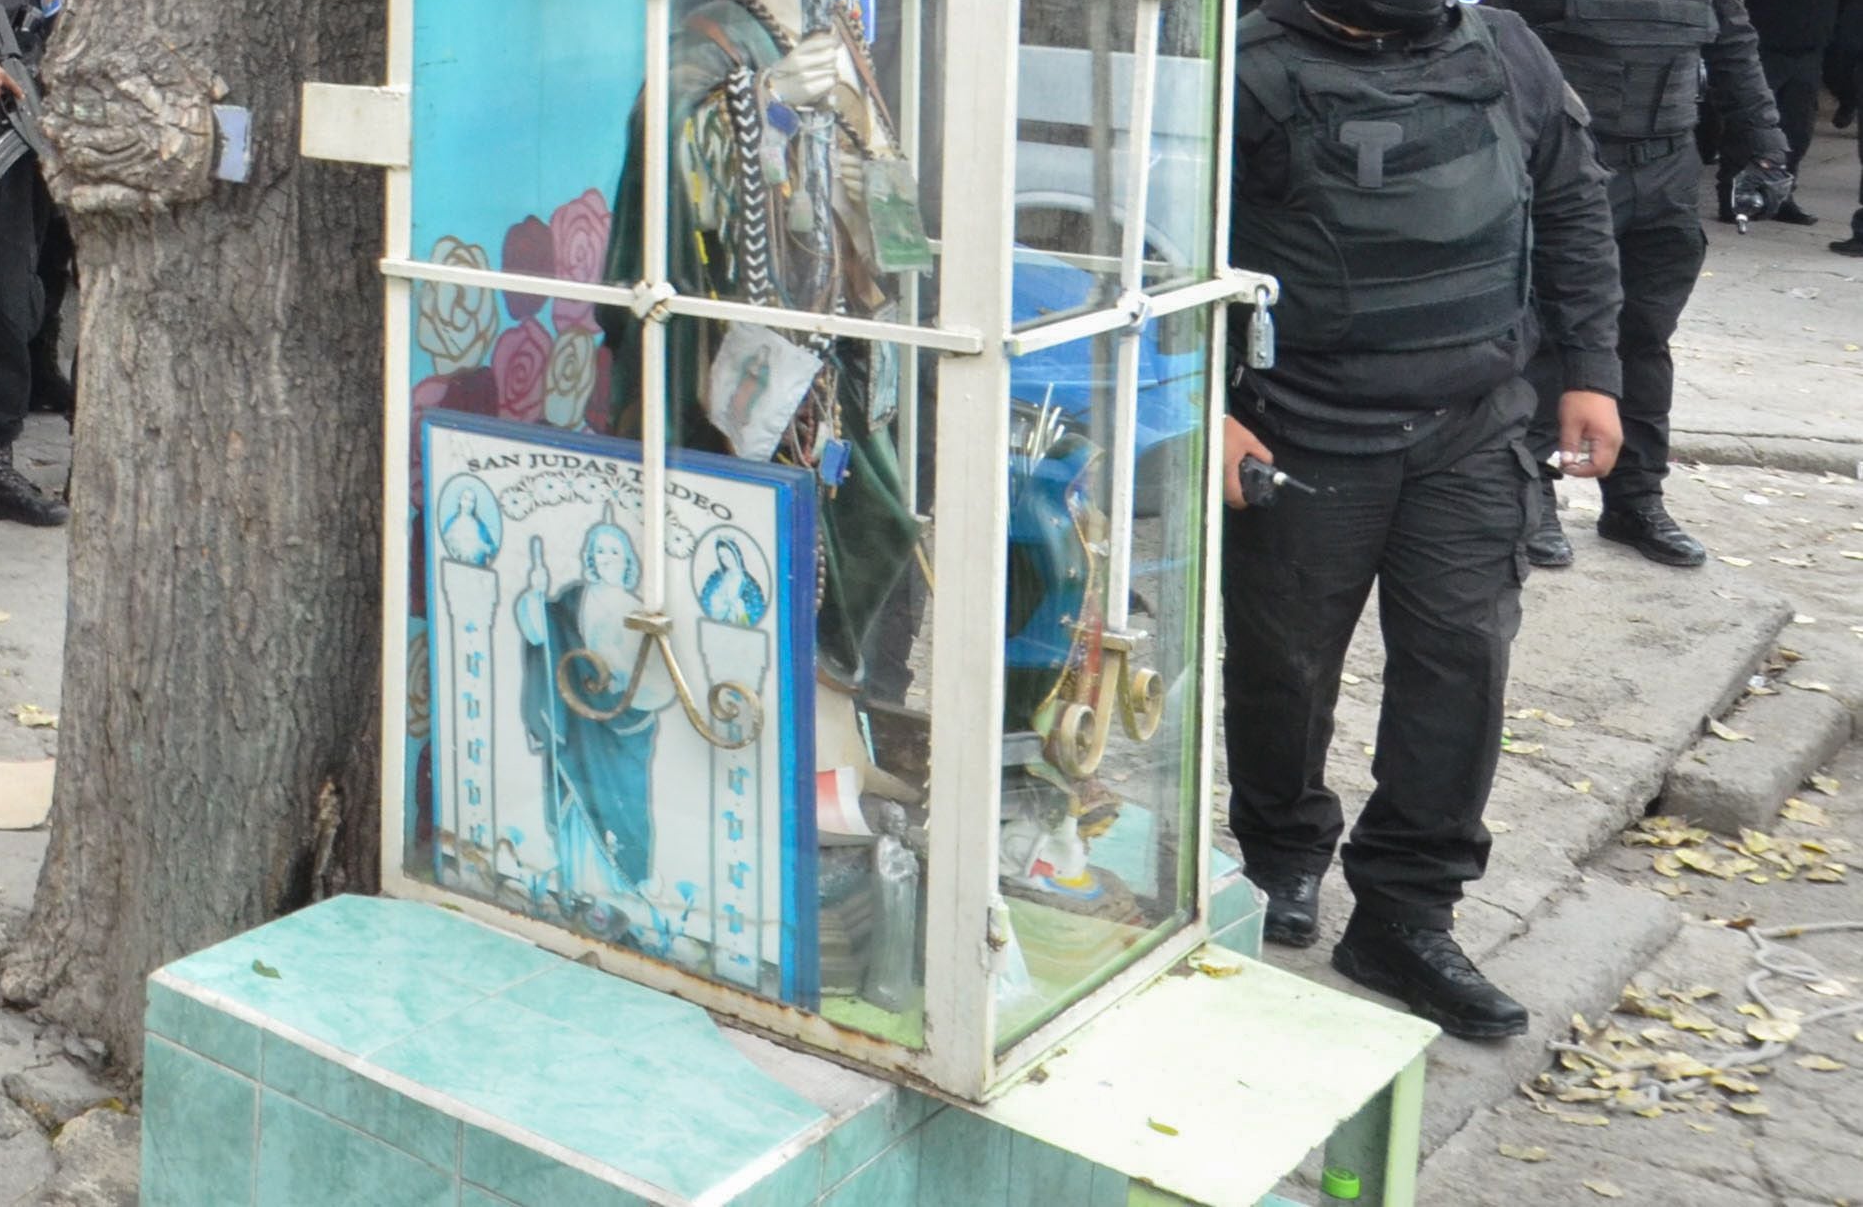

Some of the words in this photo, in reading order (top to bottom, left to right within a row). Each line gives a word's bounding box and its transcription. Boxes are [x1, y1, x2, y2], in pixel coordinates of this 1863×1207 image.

[467, 453, 520, 473] SAN
[529, 453, 618, 476] JUDAS
[628, 467, 734, 522] TDEO
